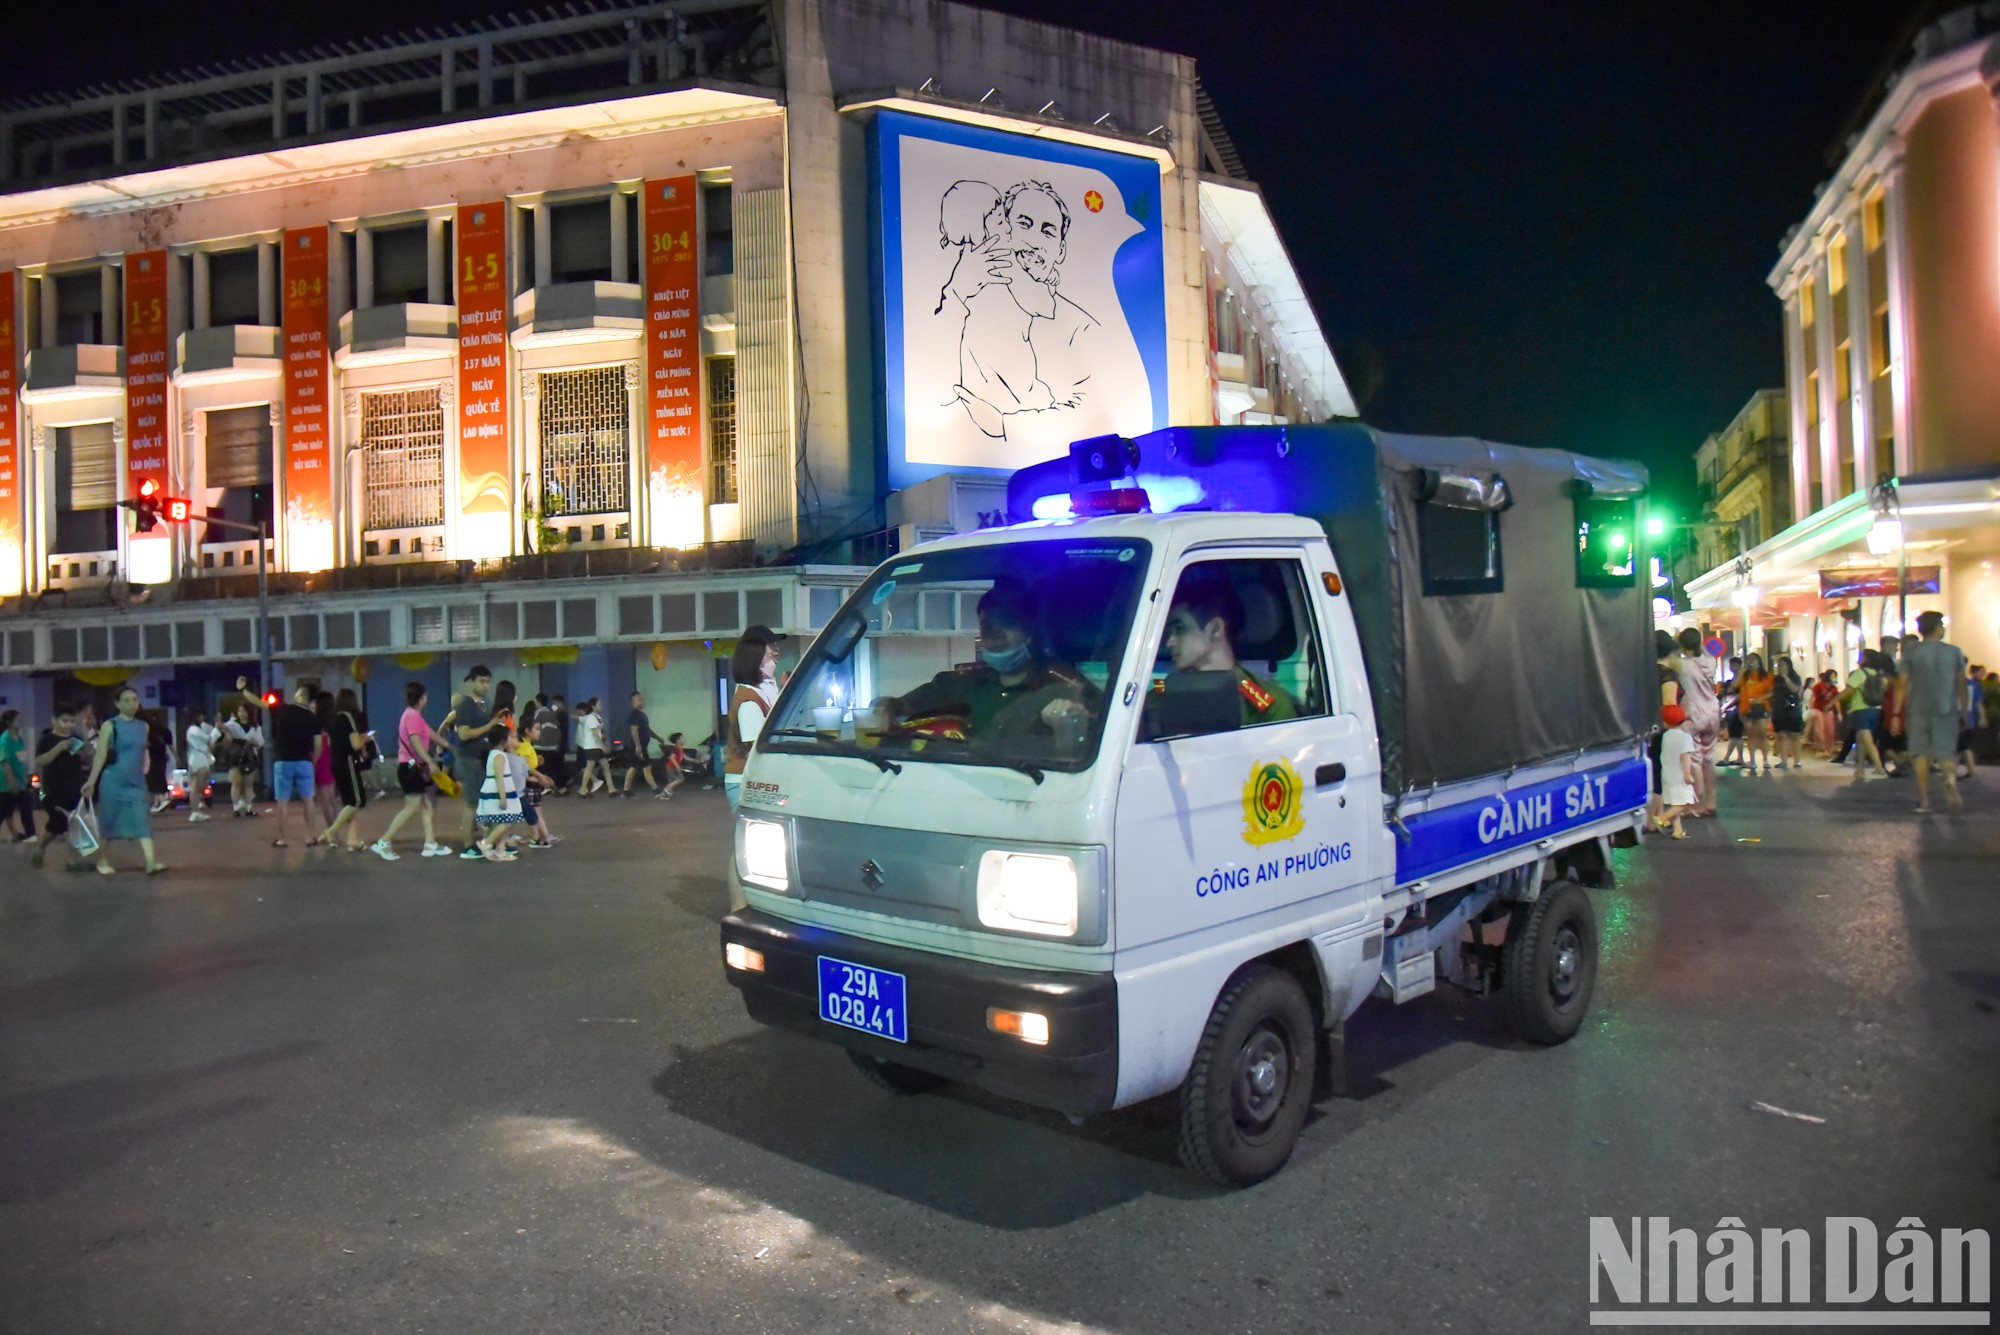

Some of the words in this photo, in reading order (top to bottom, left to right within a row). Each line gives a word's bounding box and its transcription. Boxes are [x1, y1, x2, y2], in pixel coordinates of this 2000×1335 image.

[652, 231, 689, 253] 30-4
[675, 288, 690, 300] LIỆT
[462, 310, 484, 325] NHIỆT
[485, 308, 502, 323] LIỆT
[462, 333, 480, 347] CHÀO
[464, 358, 479, 370] 137
[481, 354, 501, 368] NĂM
[472, 376, 494, 392] NGÀY
[465, 398, 489, 417] QUỐC
[489, 395, 500, 413] TẾ
[463, 427, 477, 438] LAO
[478, 423, 499, 440] ĐỘNG
[746, 781, 780, 793] SUPER
[1196, 868, 1249, 897] CÔNG
[1256, 860, 1279, 883] AN
[1285, 842, 1351, 876] PHƯỜNG
[842, 966, 879, 1000] 29A
[828, 992, 894, 1035] 028.41
